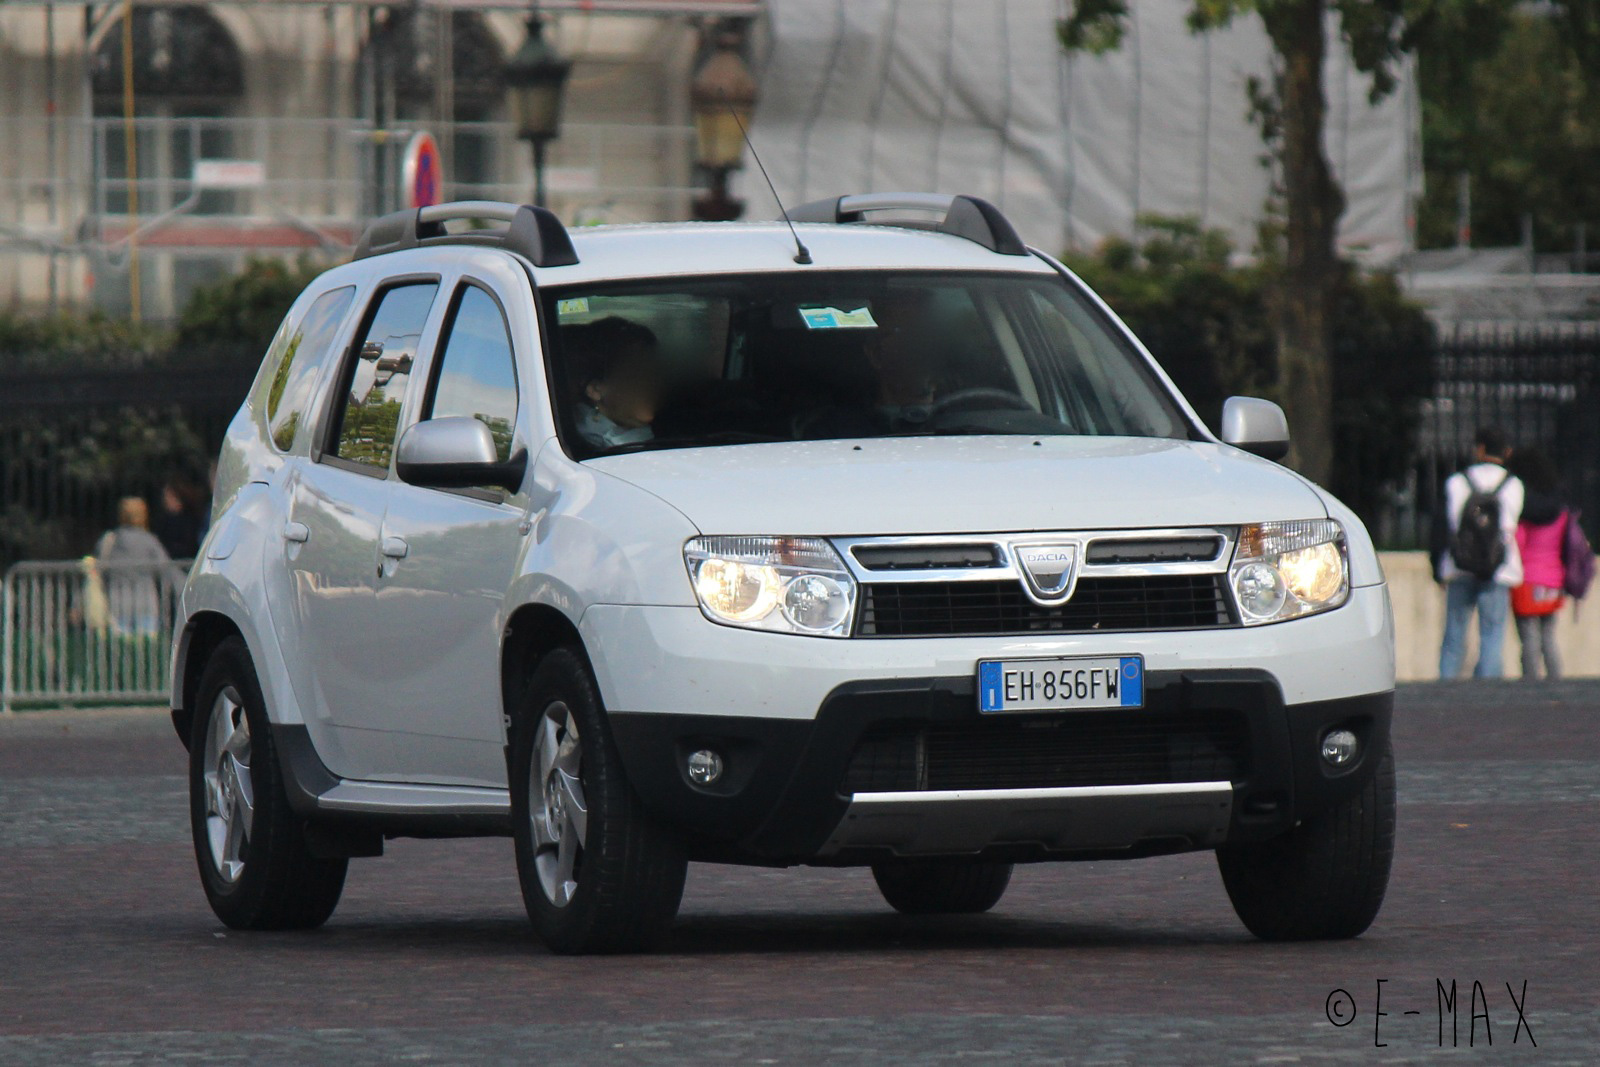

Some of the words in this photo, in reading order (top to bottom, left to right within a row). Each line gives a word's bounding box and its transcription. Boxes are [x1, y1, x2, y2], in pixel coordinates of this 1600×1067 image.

[1027, 553, 1068, 562] DACIA
[1004, 669, 1035, 701] EH
[1043, 667, 1119, 700] 856FW
